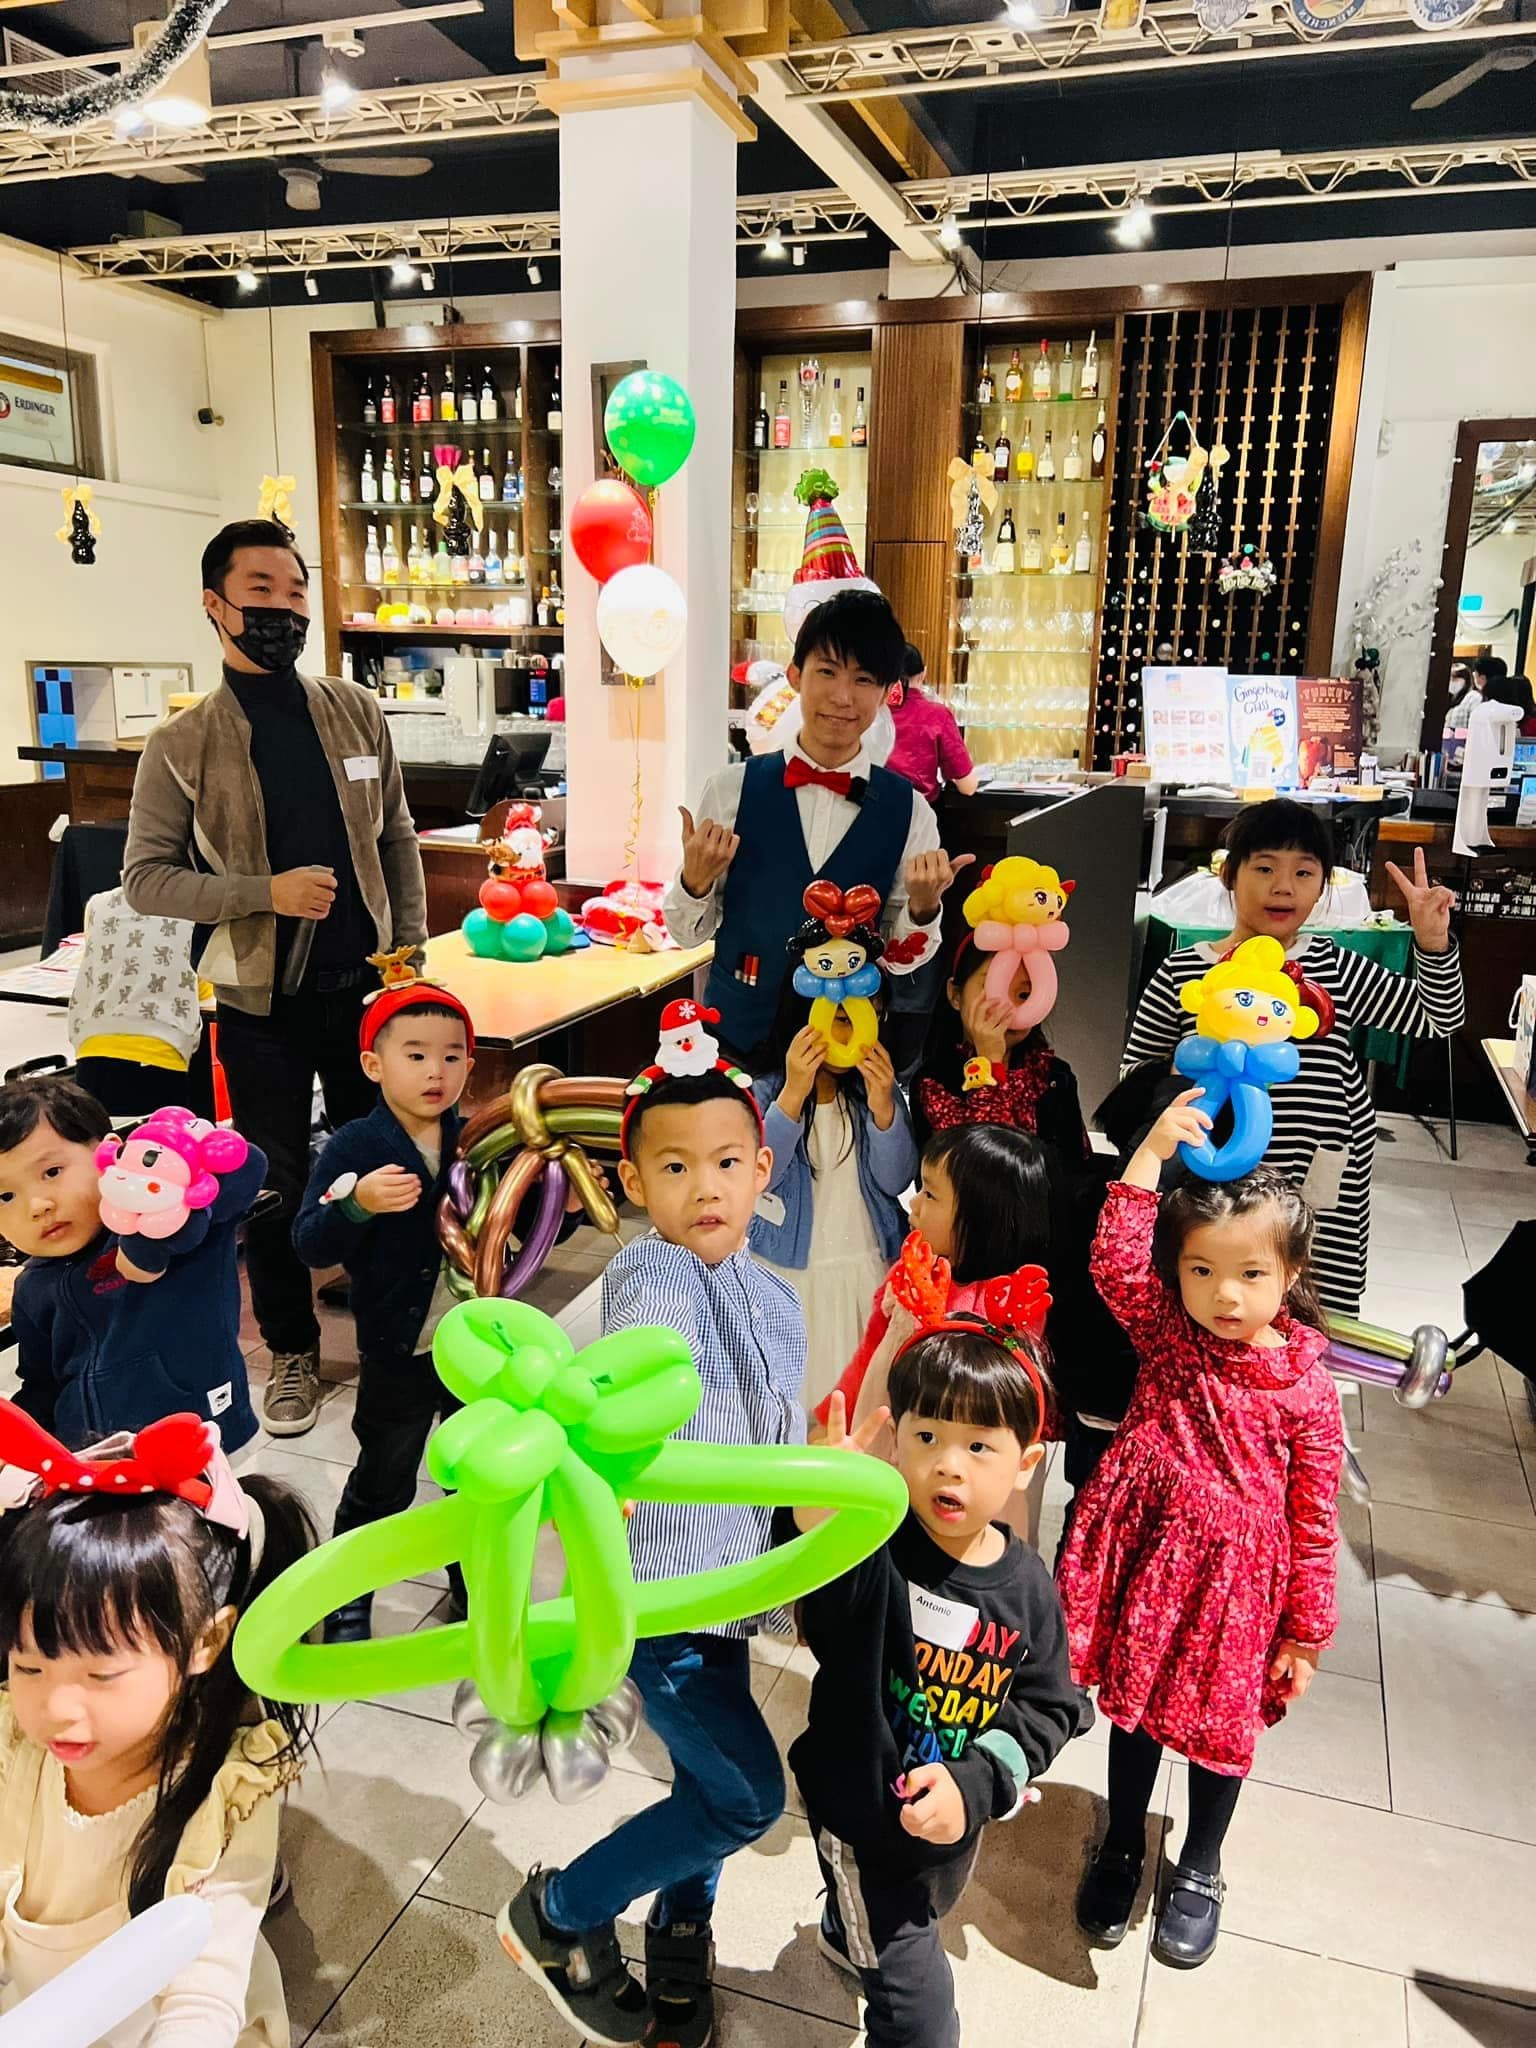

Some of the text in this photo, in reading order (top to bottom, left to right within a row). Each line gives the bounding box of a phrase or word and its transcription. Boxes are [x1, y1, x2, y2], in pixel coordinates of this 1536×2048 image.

[14, 396, 56, 417] ERDINGER
[1302, 686, 1352, 701] TURKEY
[915, 1595, 952, 1617] Antonio
